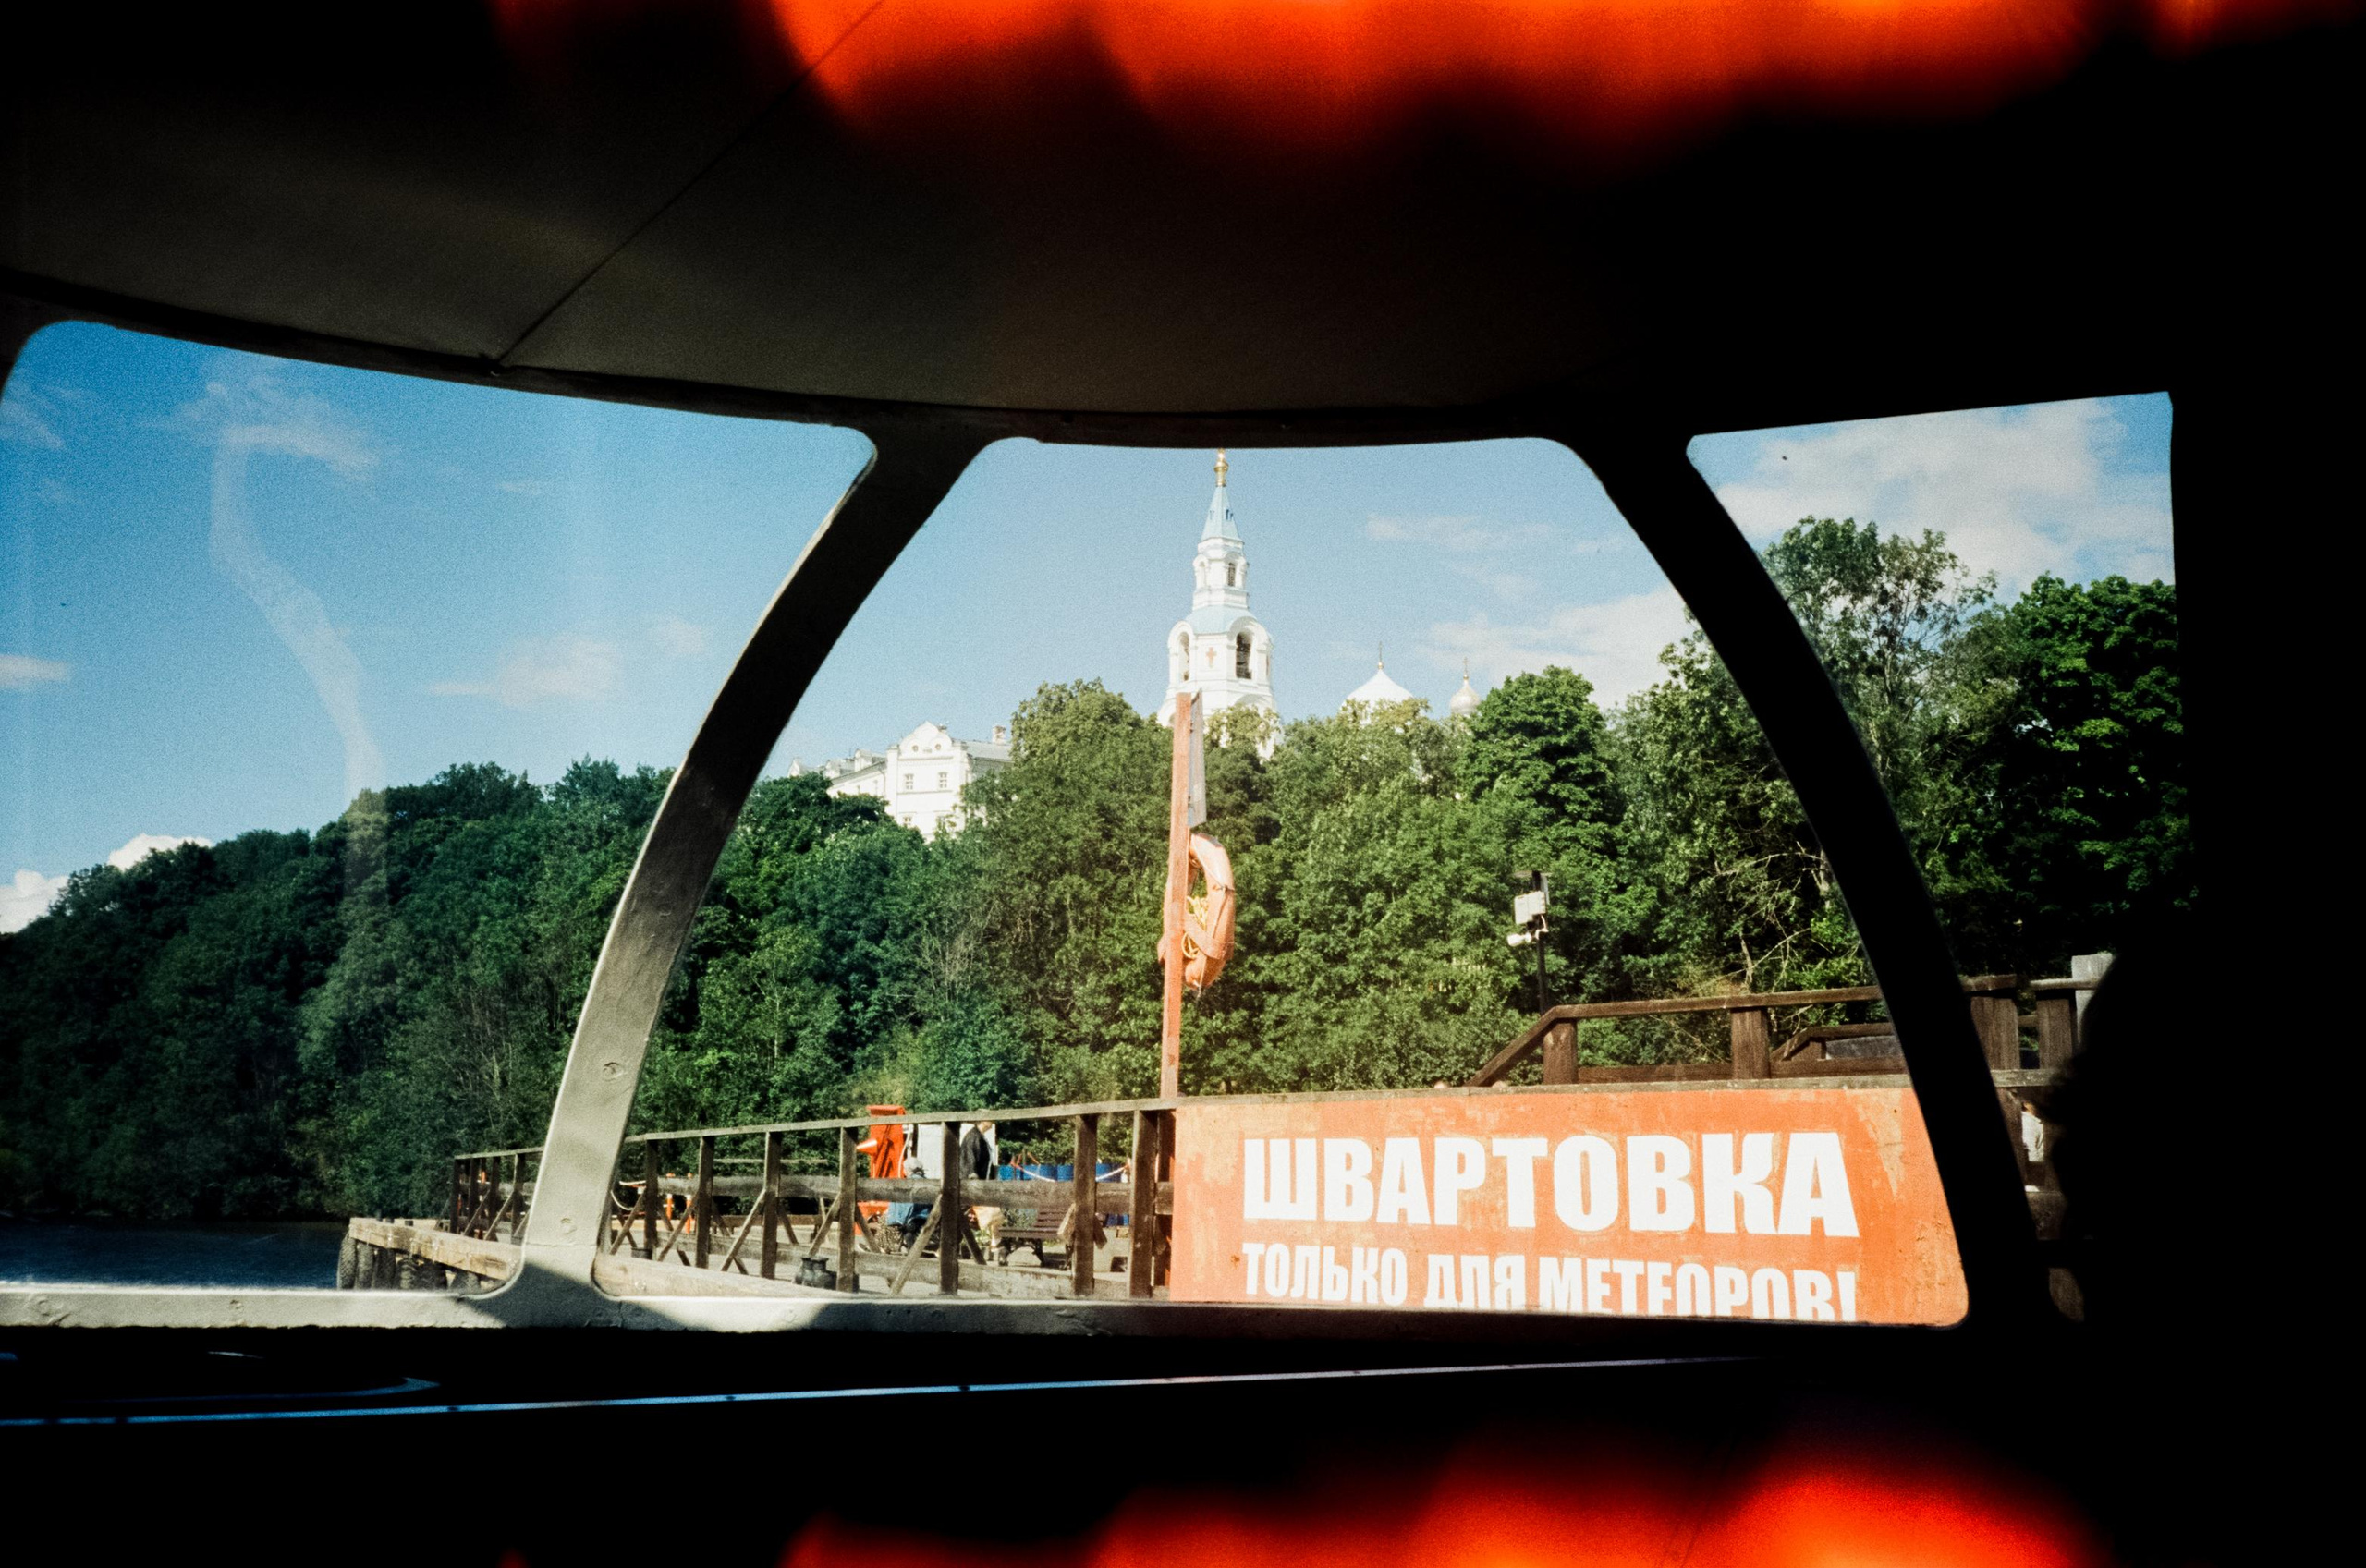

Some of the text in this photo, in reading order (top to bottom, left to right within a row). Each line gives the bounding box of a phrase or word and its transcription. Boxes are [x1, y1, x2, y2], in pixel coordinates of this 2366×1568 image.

[1243, 1131, 1860, 1239] ШВАРТОВКА
[1241, 1242, 1857, 1322] ТОЛЬКО ДЛЯ МЕТЕОРОВ!
